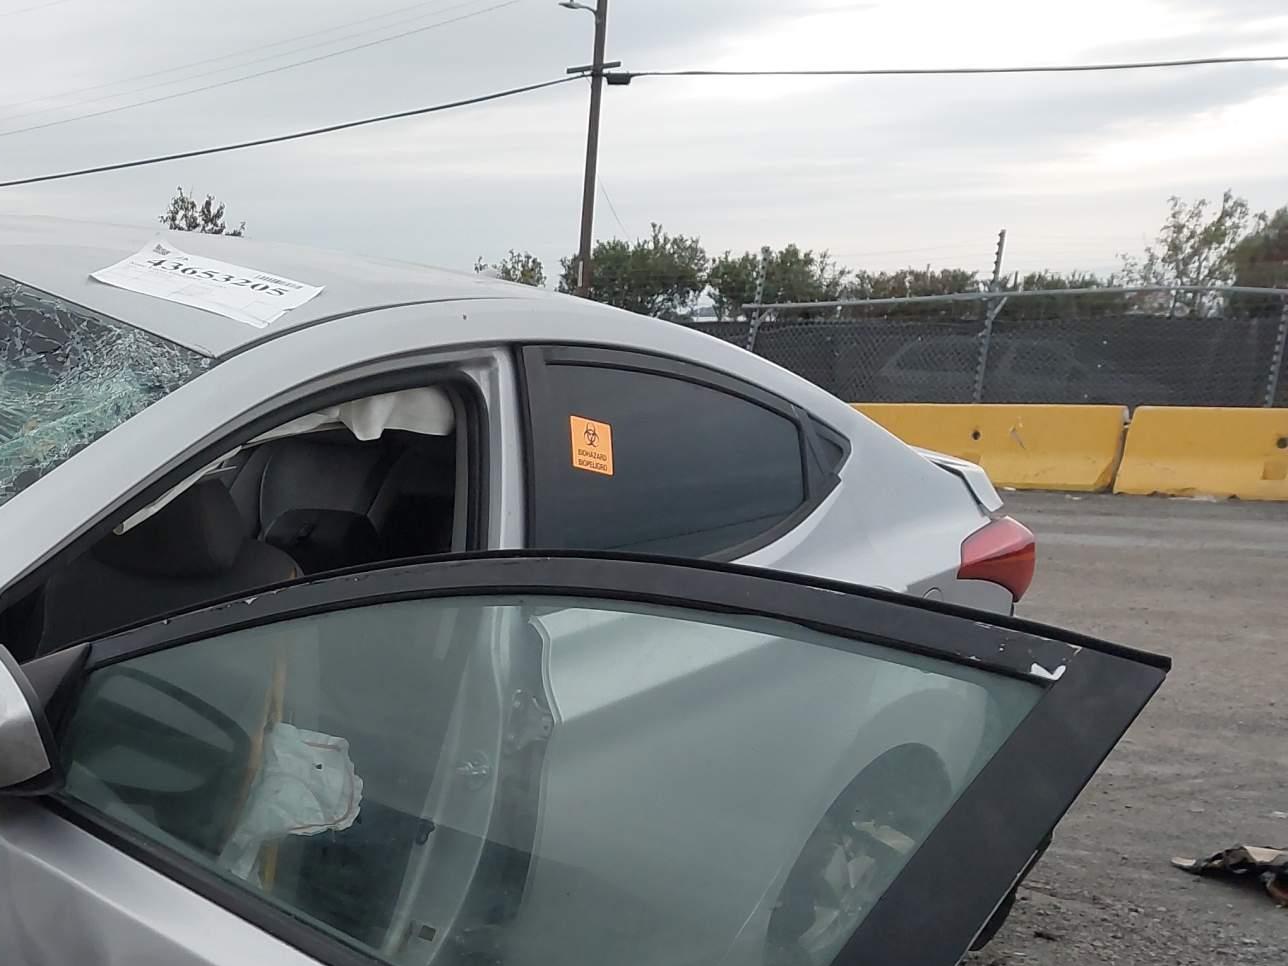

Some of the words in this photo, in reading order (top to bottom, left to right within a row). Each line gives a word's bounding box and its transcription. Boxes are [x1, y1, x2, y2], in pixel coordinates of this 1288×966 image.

[146, 258, 289, 297] 43653205
[577, 448, 608, 462] BIOHAZARD
[577, 458, 608, 472] BIOPELIGRO
